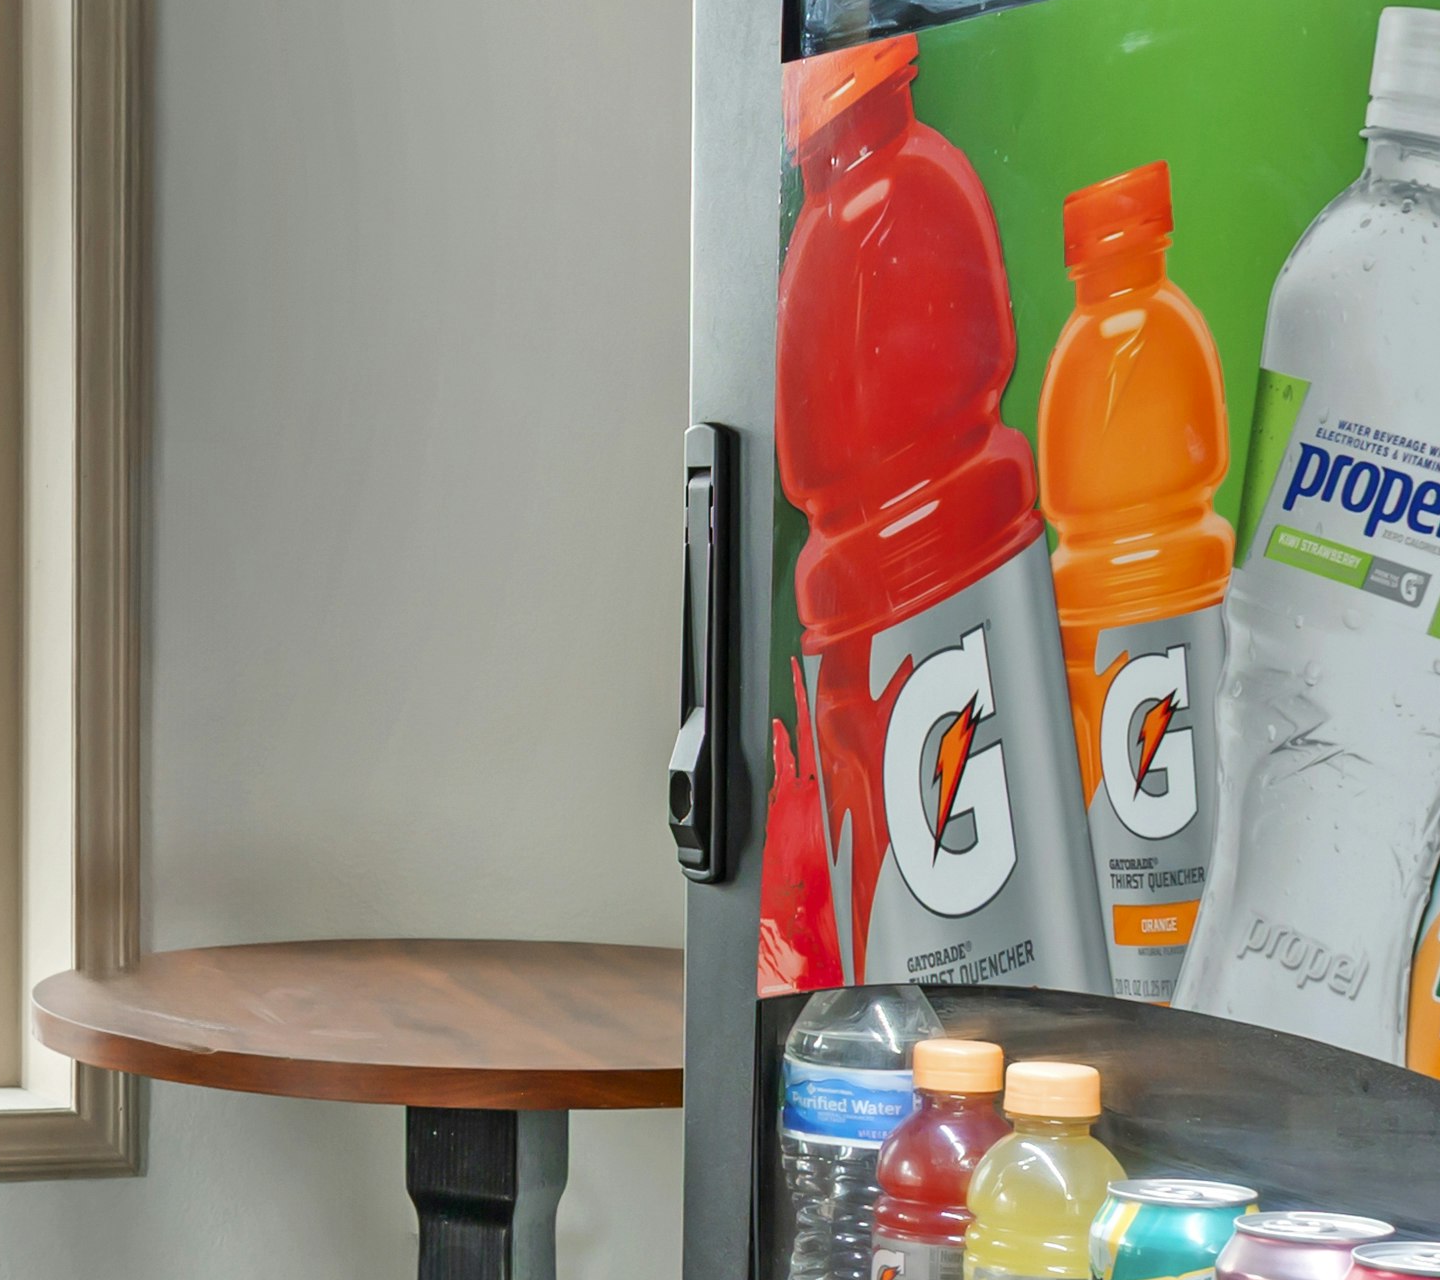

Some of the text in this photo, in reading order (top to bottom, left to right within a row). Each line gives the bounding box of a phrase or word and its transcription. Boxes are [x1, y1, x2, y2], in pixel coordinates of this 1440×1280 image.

[1315, 428, 1389, 457] ELECTROLYTES
[1392, 450, 1398, 460] &
[1338, 420, 1371, 437] WATER
[1373, 430, 1427, 453] BEVERAGE
[1109, 858, 1153, 870] GATORADE
[1110, 867, 1206, 892] THIRST QUENCHER
[1141, 918, 1178, 932] ORANGE
[852, 1099, 902, 1116] Water
